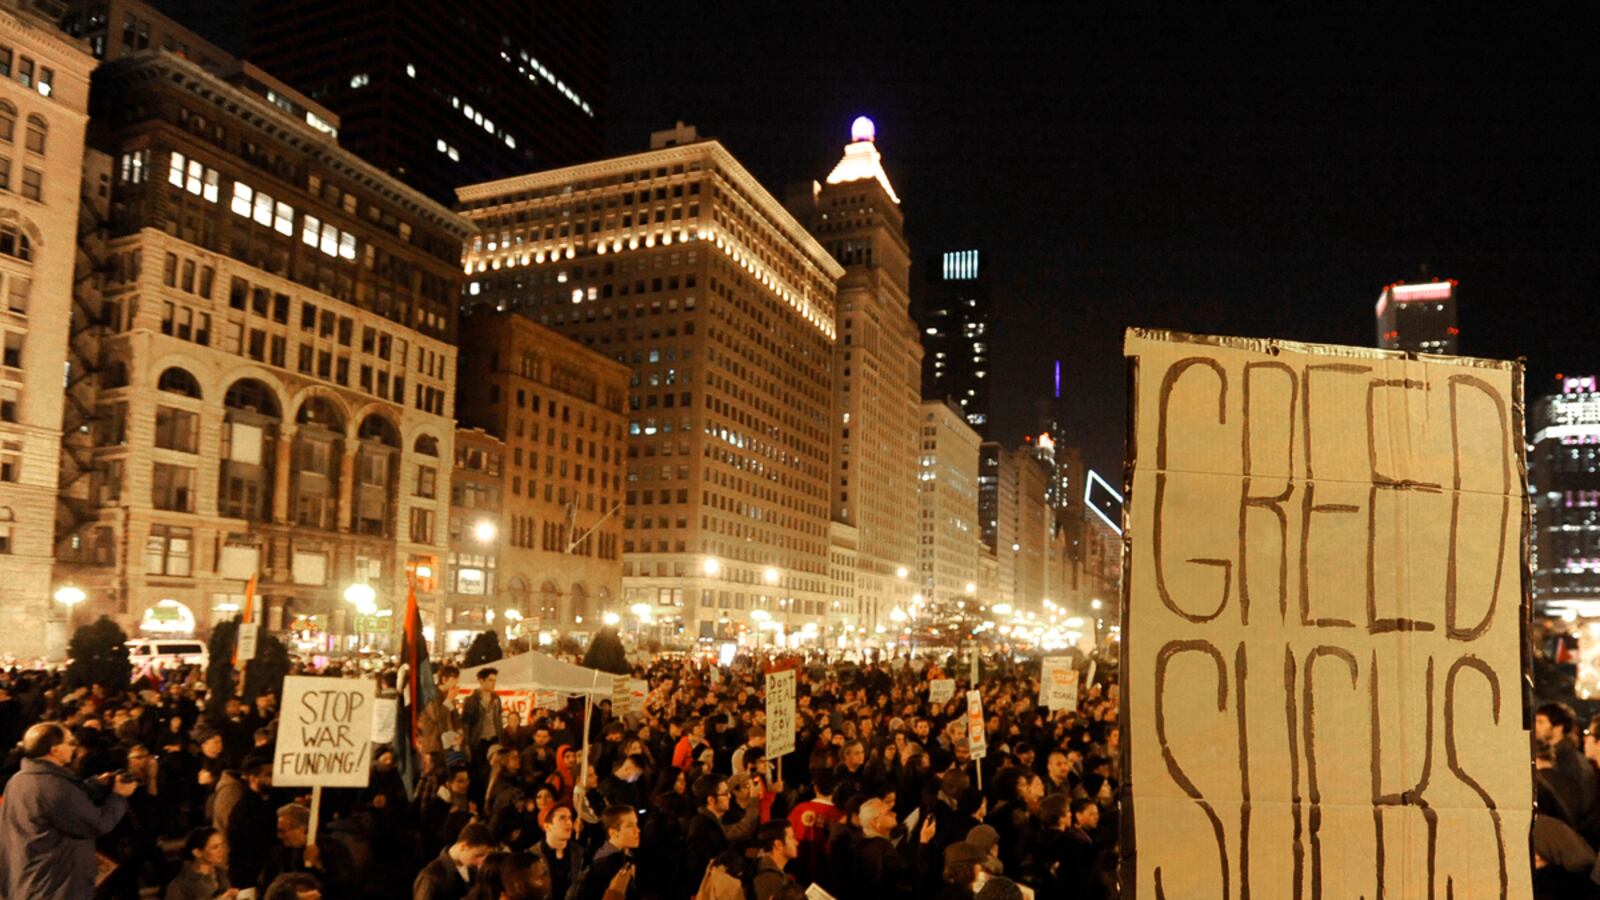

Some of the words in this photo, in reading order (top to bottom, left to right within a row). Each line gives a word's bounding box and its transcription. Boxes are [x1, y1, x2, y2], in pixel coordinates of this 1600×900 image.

[1153, 356, 1511, 642] GREED
[299, 690, 365, 725] STOP
[302, 724, 355, 748] WAR
[280, 742, 368, 775] FUNDING!
[1154, 639, 1509, 900] SUCKS
